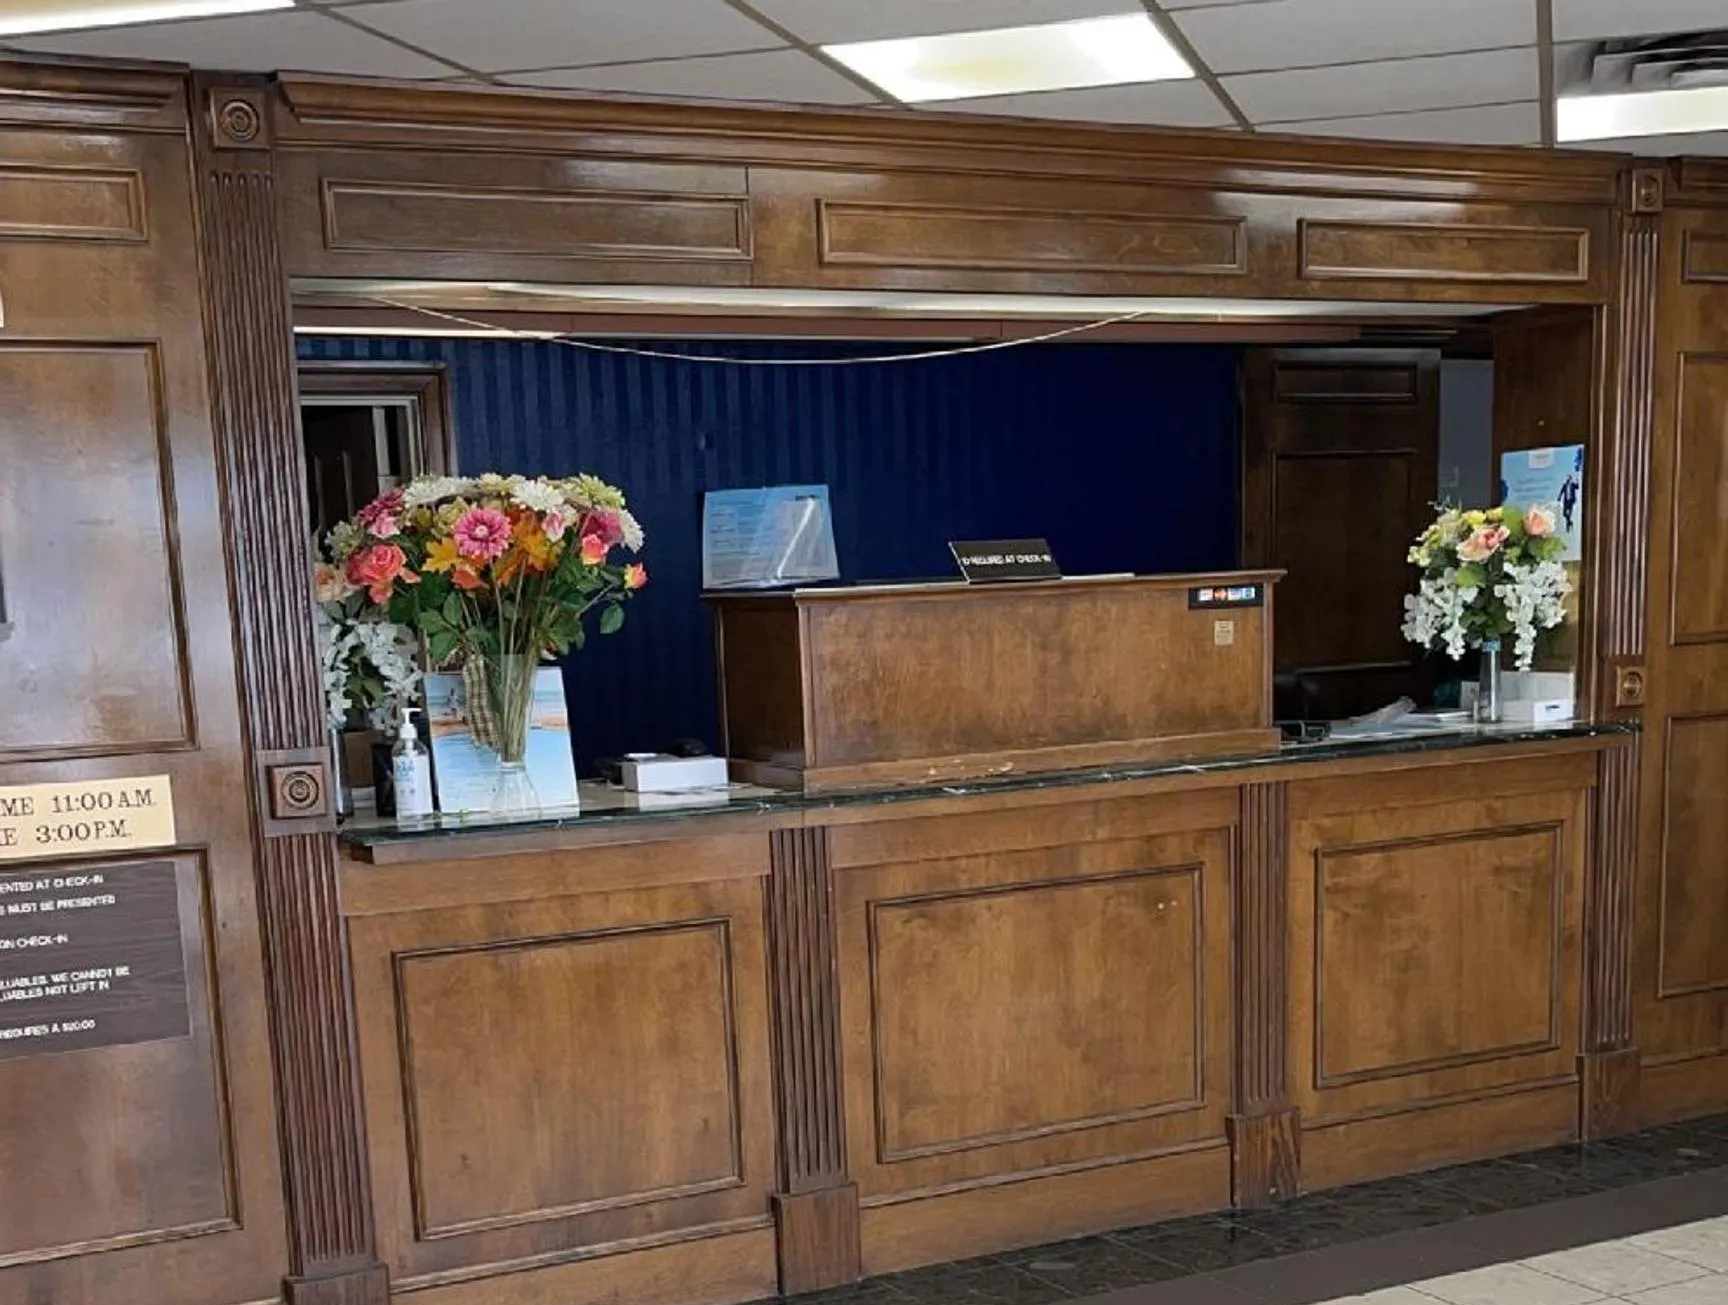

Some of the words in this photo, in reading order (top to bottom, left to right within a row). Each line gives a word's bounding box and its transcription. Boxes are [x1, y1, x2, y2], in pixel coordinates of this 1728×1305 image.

[52, 791, 113, 813] 11:00
[36, 822, 91, 843] 3:00
[36, 878, 50, 890] AT
[7, 902, 37, 914] MUST
[40, 900, 54, 911] BE
[57, 894, 116, 909] PRESENTED
[50, 972, 69, 982] WE
[70, 968, 113, 981] CANNOT
[115, 965, 130, 977] BE
[45, 984, 67, 996] NOT
[69, 981, 97, 994] LEFT
[99, 979, 110, 991] IN
[51, 1022, 61, 1033] A
